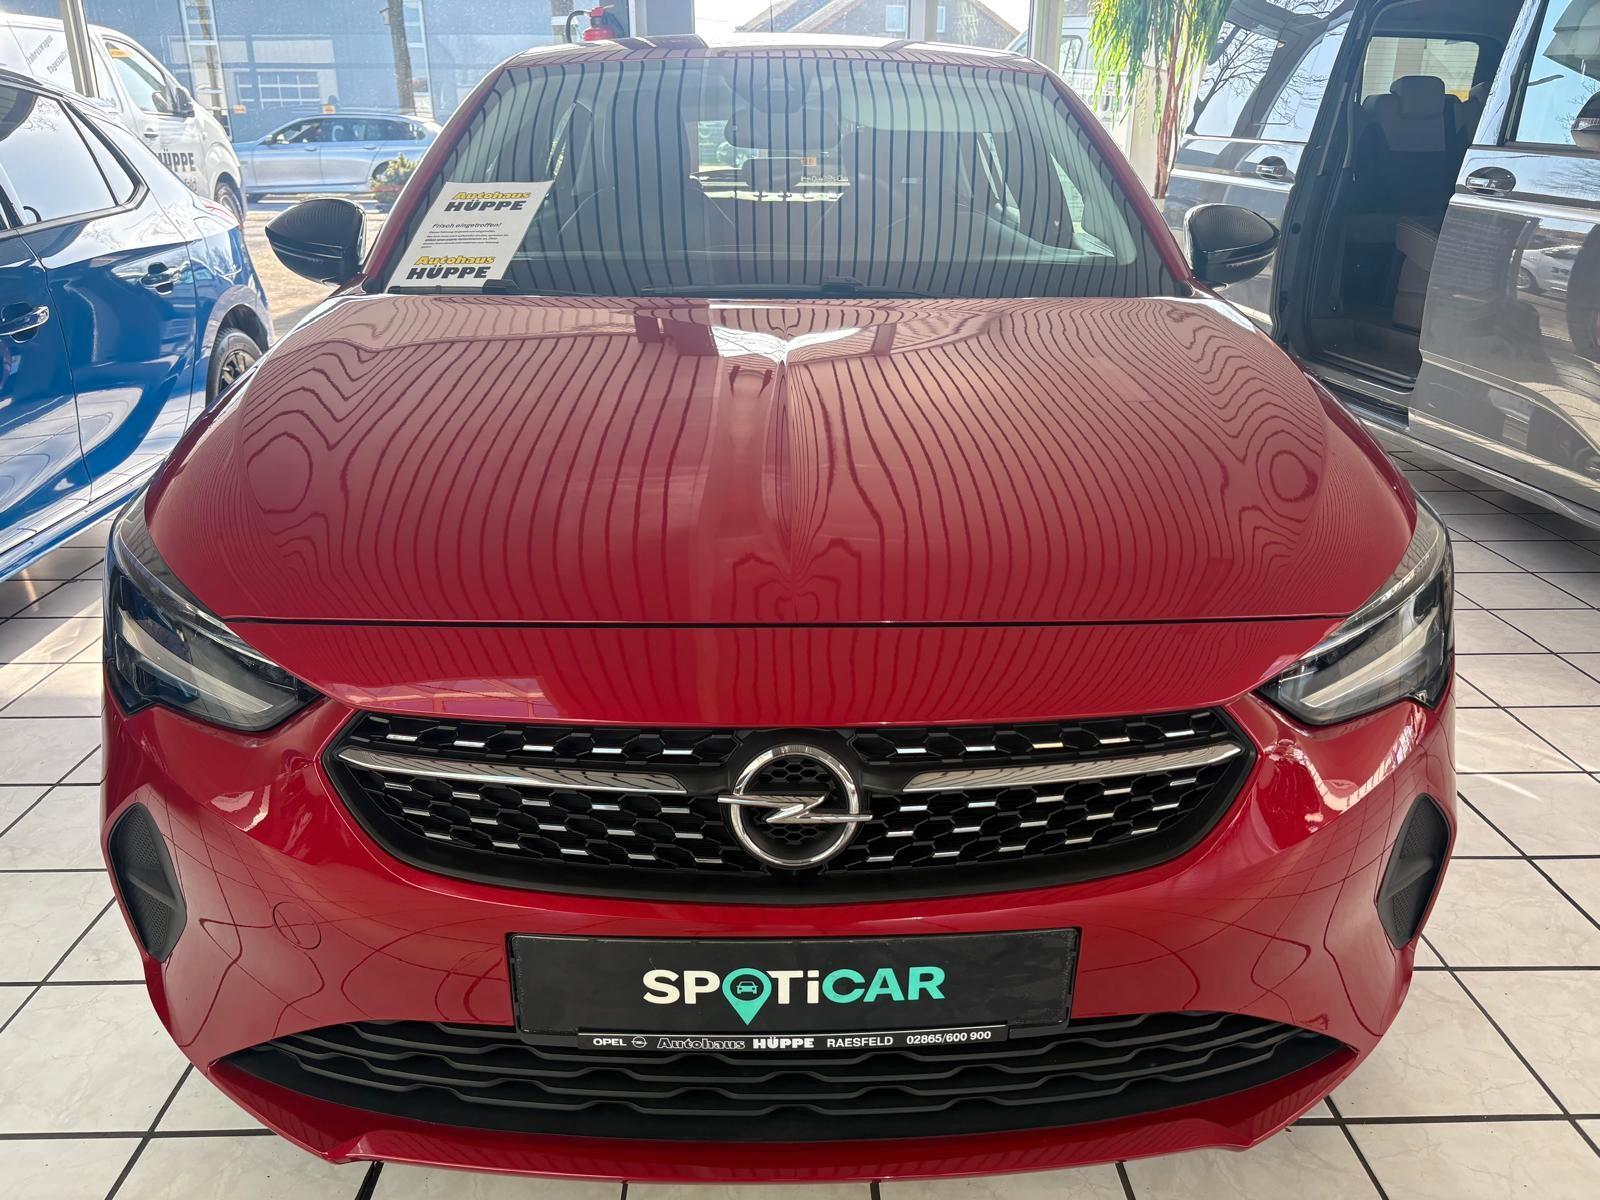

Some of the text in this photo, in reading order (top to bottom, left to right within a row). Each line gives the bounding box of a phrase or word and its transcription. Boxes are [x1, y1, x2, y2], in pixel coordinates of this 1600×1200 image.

[451, 191, 531, 200] Autohaus
[444, 199, 527, 212] HÜPPE
[414, 255, 496, 265] Autohaus
[406, 264, 491, 280] HÜPPE
[592, 1030, 992, 1050] OPEL Autohaus HÜPPE RAESFELD 02865/600 900
